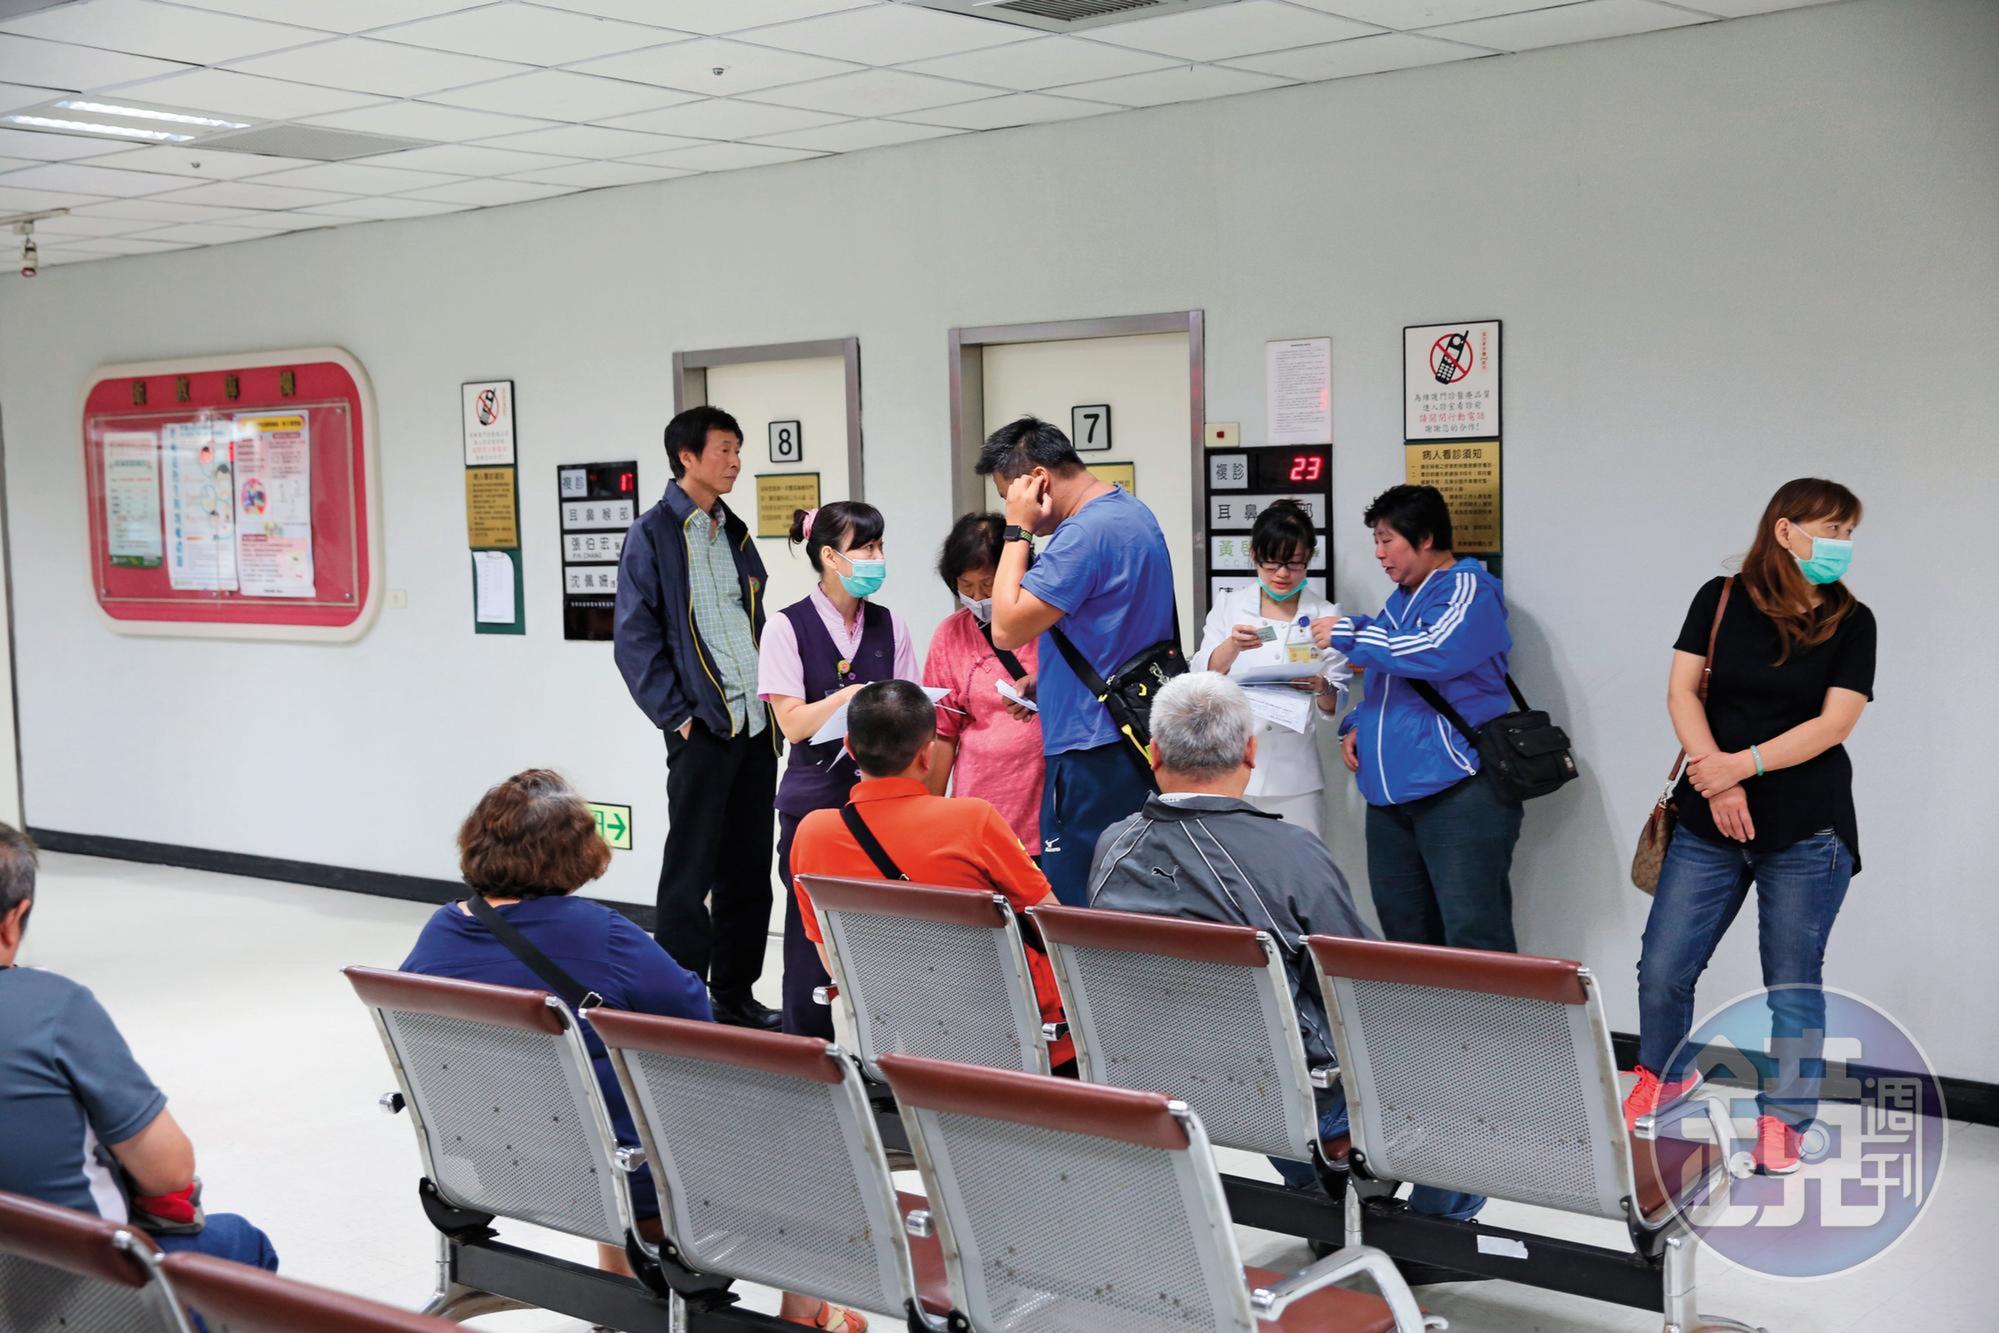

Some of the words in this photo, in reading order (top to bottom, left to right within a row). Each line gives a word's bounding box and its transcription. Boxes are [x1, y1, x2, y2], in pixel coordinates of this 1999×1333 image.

[1083, 413, 1100, 443] 7
[778, 428, 792, 455] 8
[1422, 449, 1482, 460] 病人看診須知
[1216, 463, 1245, 480] 複診
[1289, 456, 1322, 481] 23
[1217, 503, 1314, 521] 耳鼻部
